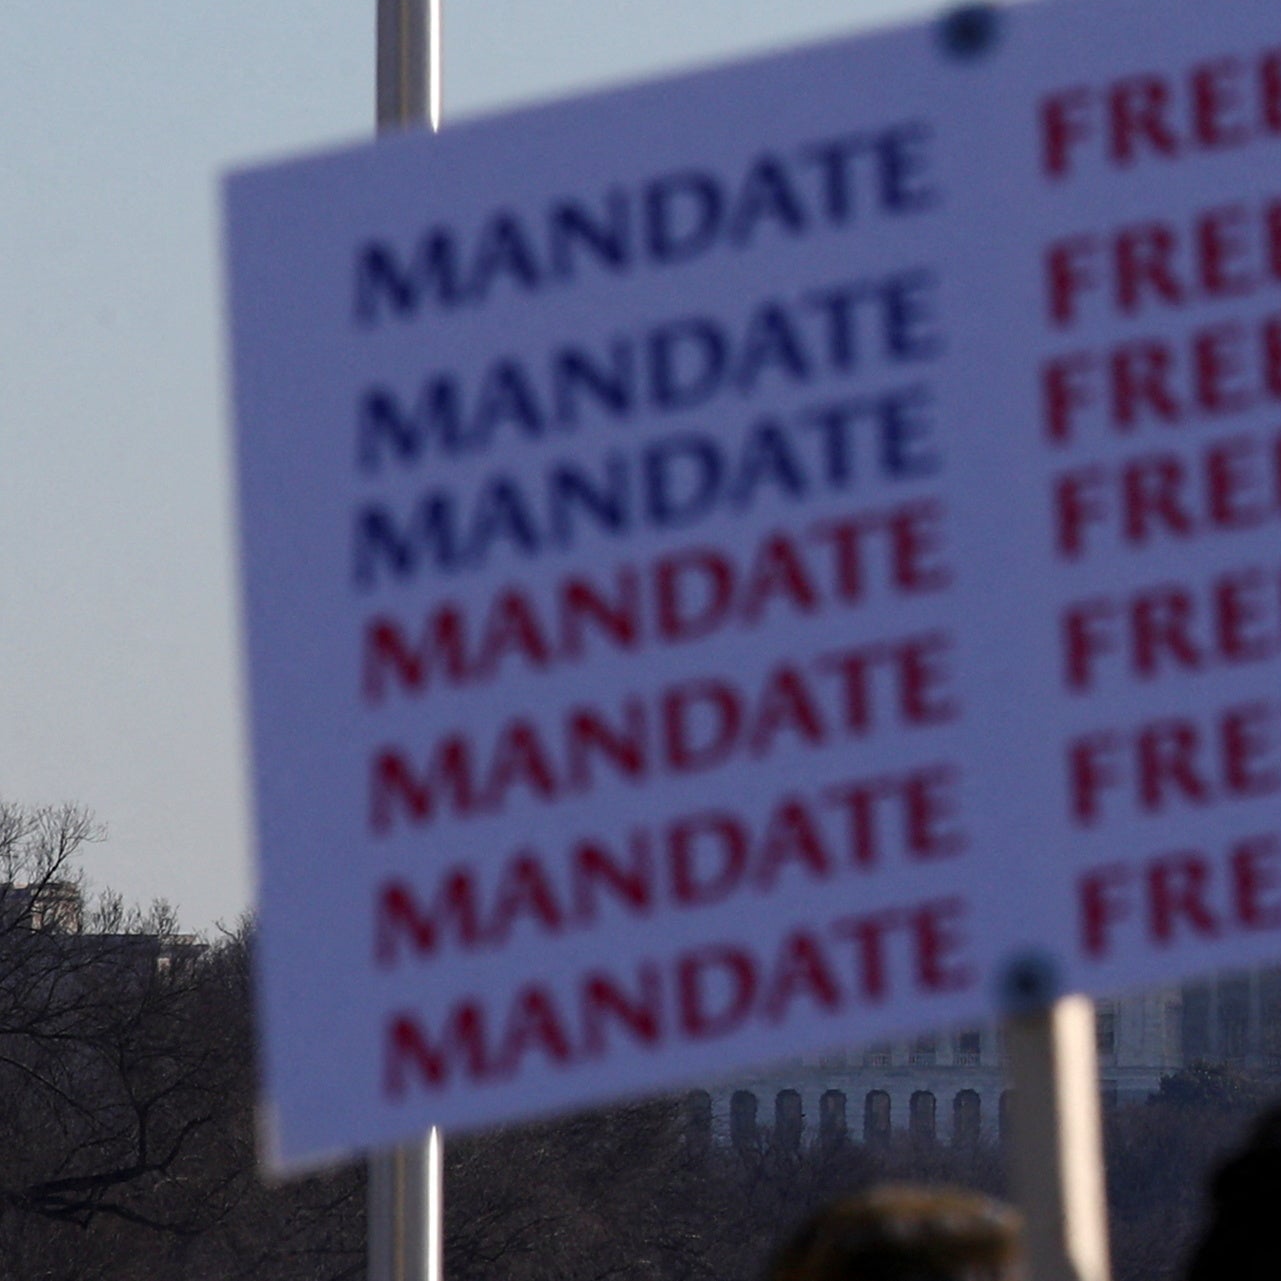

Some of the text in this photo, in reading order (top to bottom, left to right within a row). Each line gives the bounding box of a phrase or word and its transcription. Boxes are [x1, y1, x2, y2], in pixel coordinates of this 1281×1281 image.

[354, 125, 932, 324] MANDATE
[357, 271, 935, 473] MANDATE
[353, 387, 934, 589] MANDATE
[363, 502, 947, 701] MANDATE
[369, 634, 954, 834] MANDATE
[375, 767, 960, 966] MANDATE
[383, 899, 969, 1099] MANDATE
